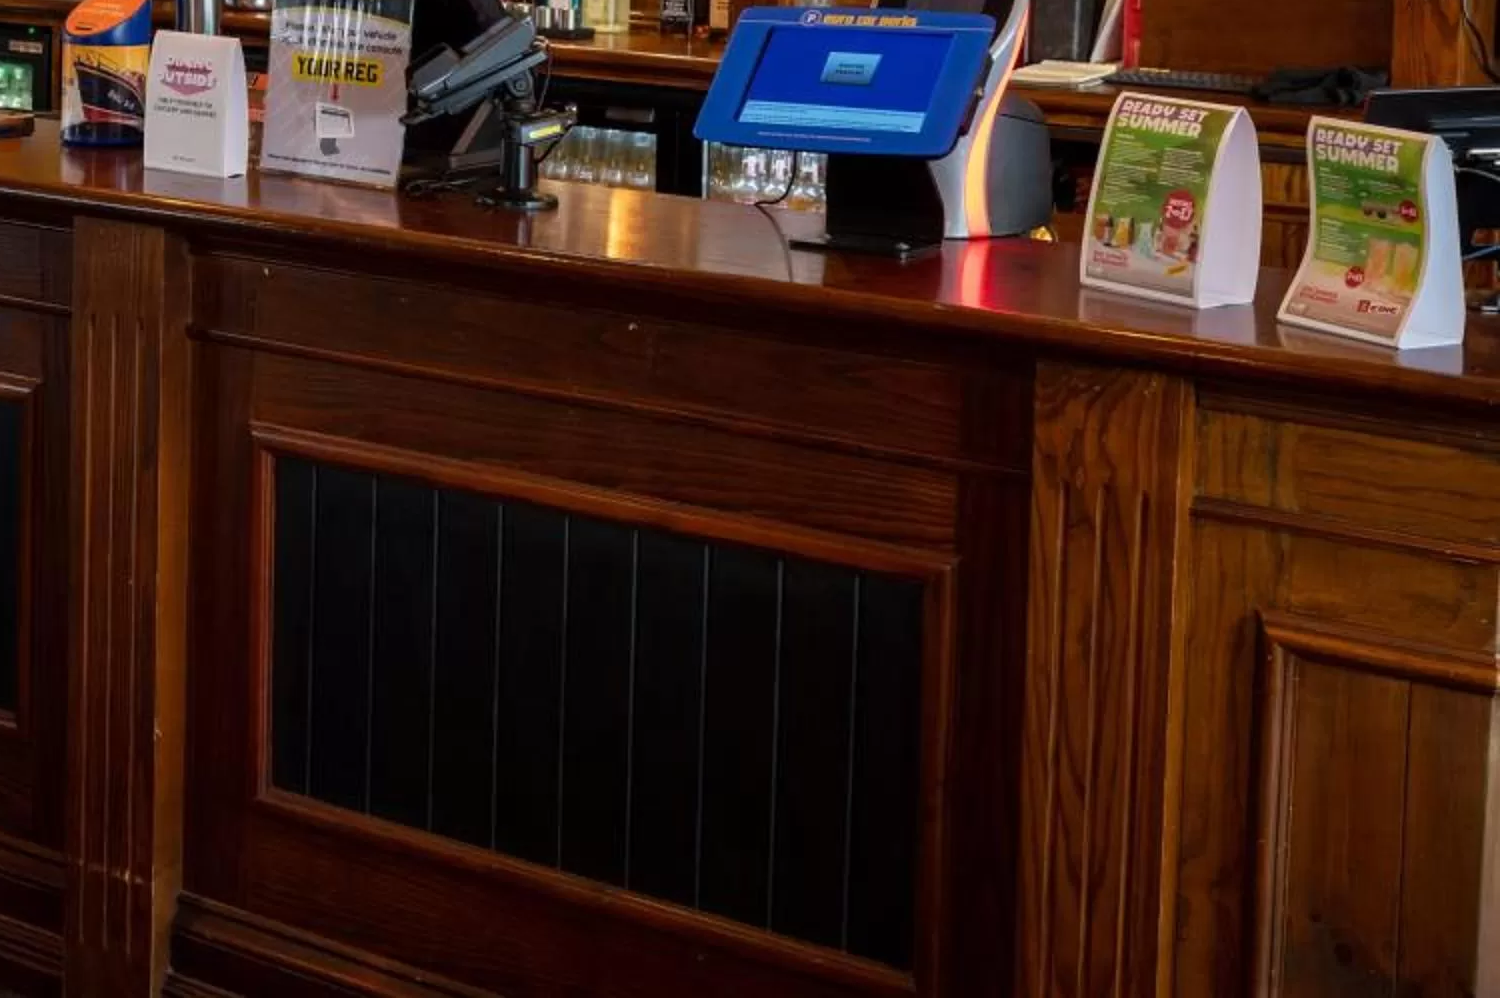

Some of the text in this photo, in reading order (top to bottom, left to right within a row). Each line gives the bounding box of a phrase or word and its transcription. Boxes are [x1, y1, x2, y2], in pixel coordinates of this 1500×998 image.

[296, 55, 379, 84] YOUR REG
[1120, 99, 1211, 123] READY SET
[1116, 113, 1203, 139] SUMMER
[1315, 128, 1404, 156] READY SET
[1315, 144, 1400, 173] SUMMER
